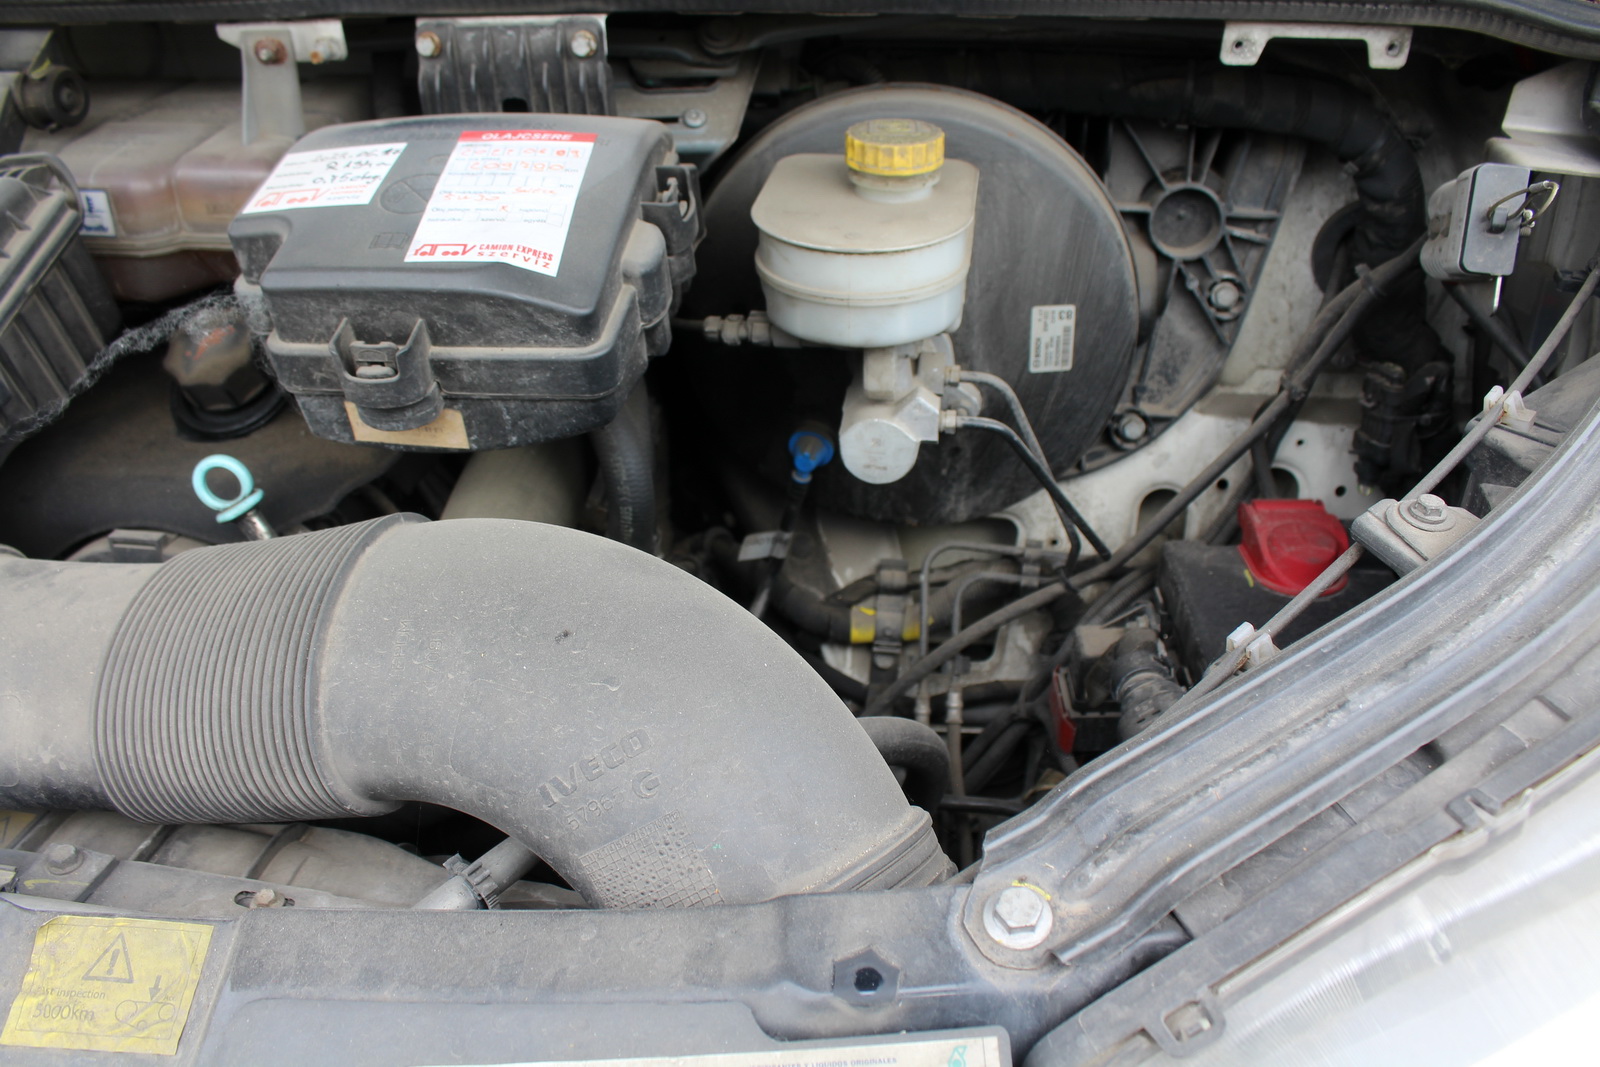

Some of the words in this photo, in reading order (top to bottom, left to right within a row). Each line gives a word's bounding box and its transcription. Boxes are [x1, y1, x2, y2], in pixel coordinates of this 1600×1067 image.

[481, 133, 574, 141] OLAJCSERE
[477, 251, 551, 270] szerviz
[517, 245, 555, 262] EXPRESS
[537, 727, 653, 810] IVECO
[56, 987, 107, 1001] inspection
[850, 1057, 898, 1066] ORIGINALES
